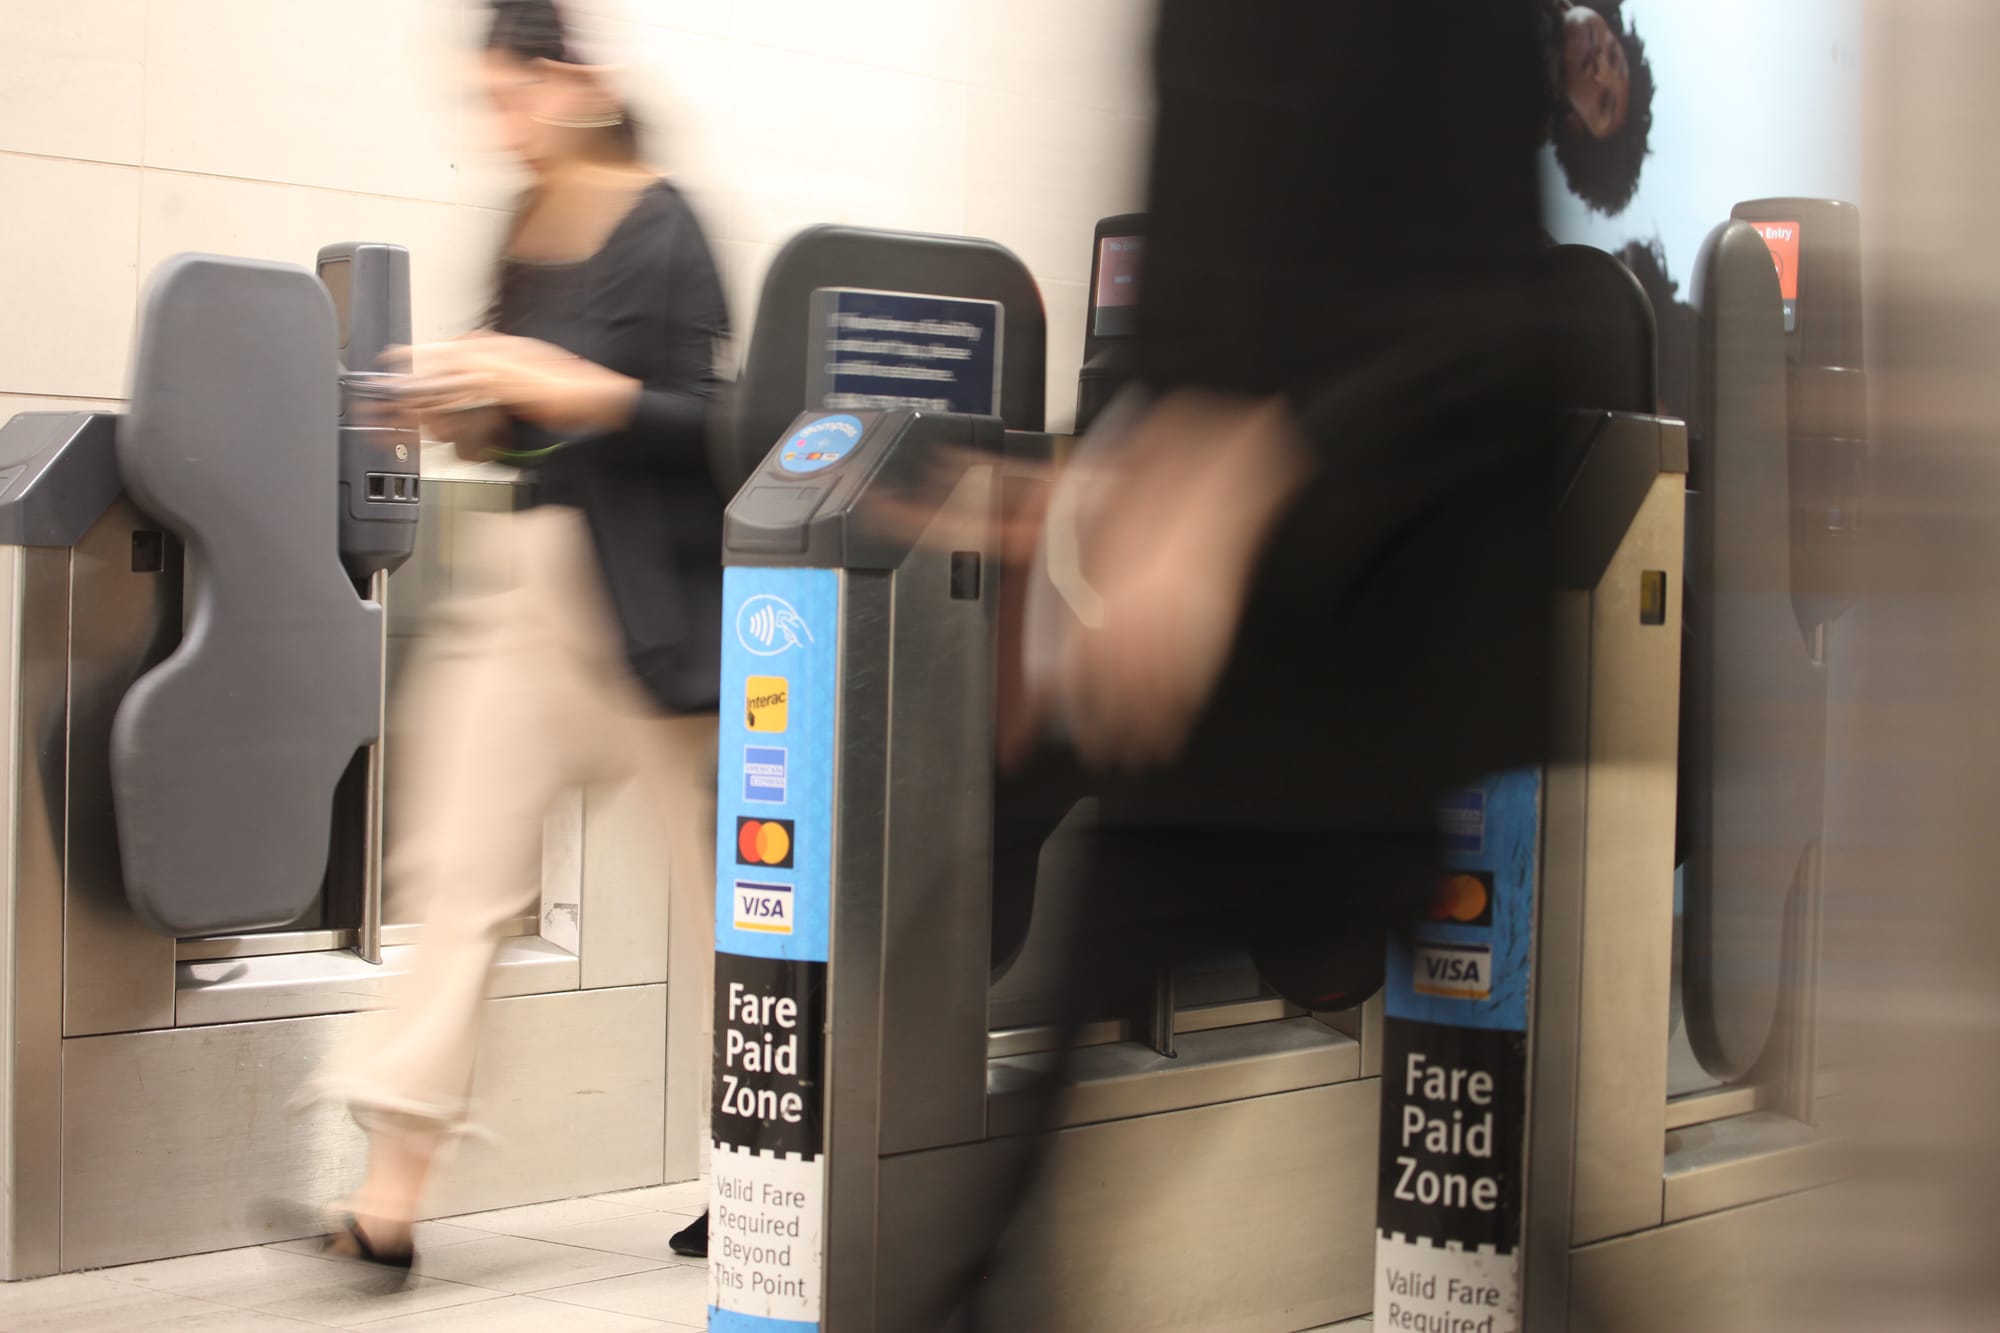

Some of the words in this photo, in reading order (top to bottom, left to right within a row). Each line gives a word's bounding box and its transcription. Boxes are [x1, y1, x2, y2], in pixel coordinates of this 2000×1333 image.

[1765, 227, 1792, 241] Entry
[742, 896, 784, 918] VISA
[1426, 956, 1480, 983] VISA
[728, 982, 798, 1028] Fare
[726, 1029, 798, 1076] Paid
[1405, 1053, 1494, 1105] Fare
[721, 1075, 803, 1123] Zone
[1402, 1105, 1493, 1158] Paid
[716, 1175, 753, 1203] Valid
[762, 1184, 805, 1209] Fare
[1394, 1156, 1498, 1211] Zone
[718, 1205, 800, 1238] Required
[723, 1236, 791, 1267] Beyond
[715, 1262, 744, 1290] This
[751, 1271, 805, 1299] Point
[1386, 1268, 1436, 1300] Valid
[1448, 1279, 1500, 1307] Fare
[1388, 1302, 1494, 1333] Required
